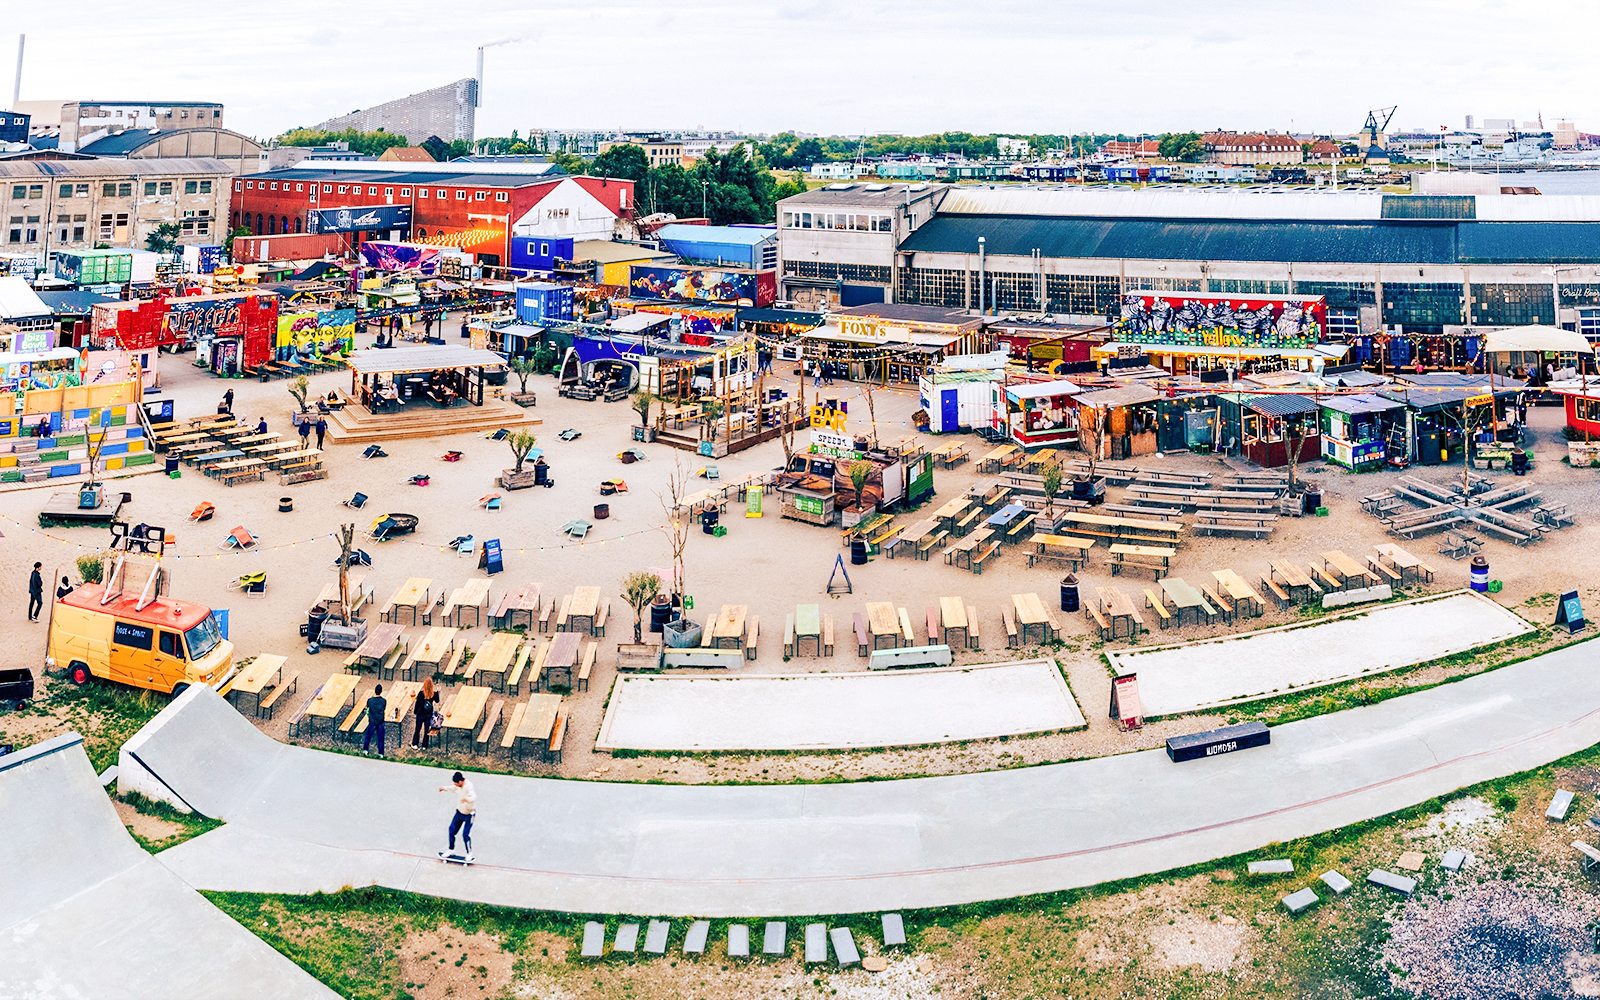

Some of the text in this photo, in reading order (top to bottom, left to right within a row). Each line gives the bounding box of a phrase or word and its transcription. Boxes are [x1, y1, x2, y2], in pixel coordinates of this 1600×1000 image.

[21, 340, 47, 350] Bowls
[810, 405, 848, 433] BAR
[817, 446, 832, 455] BEER
